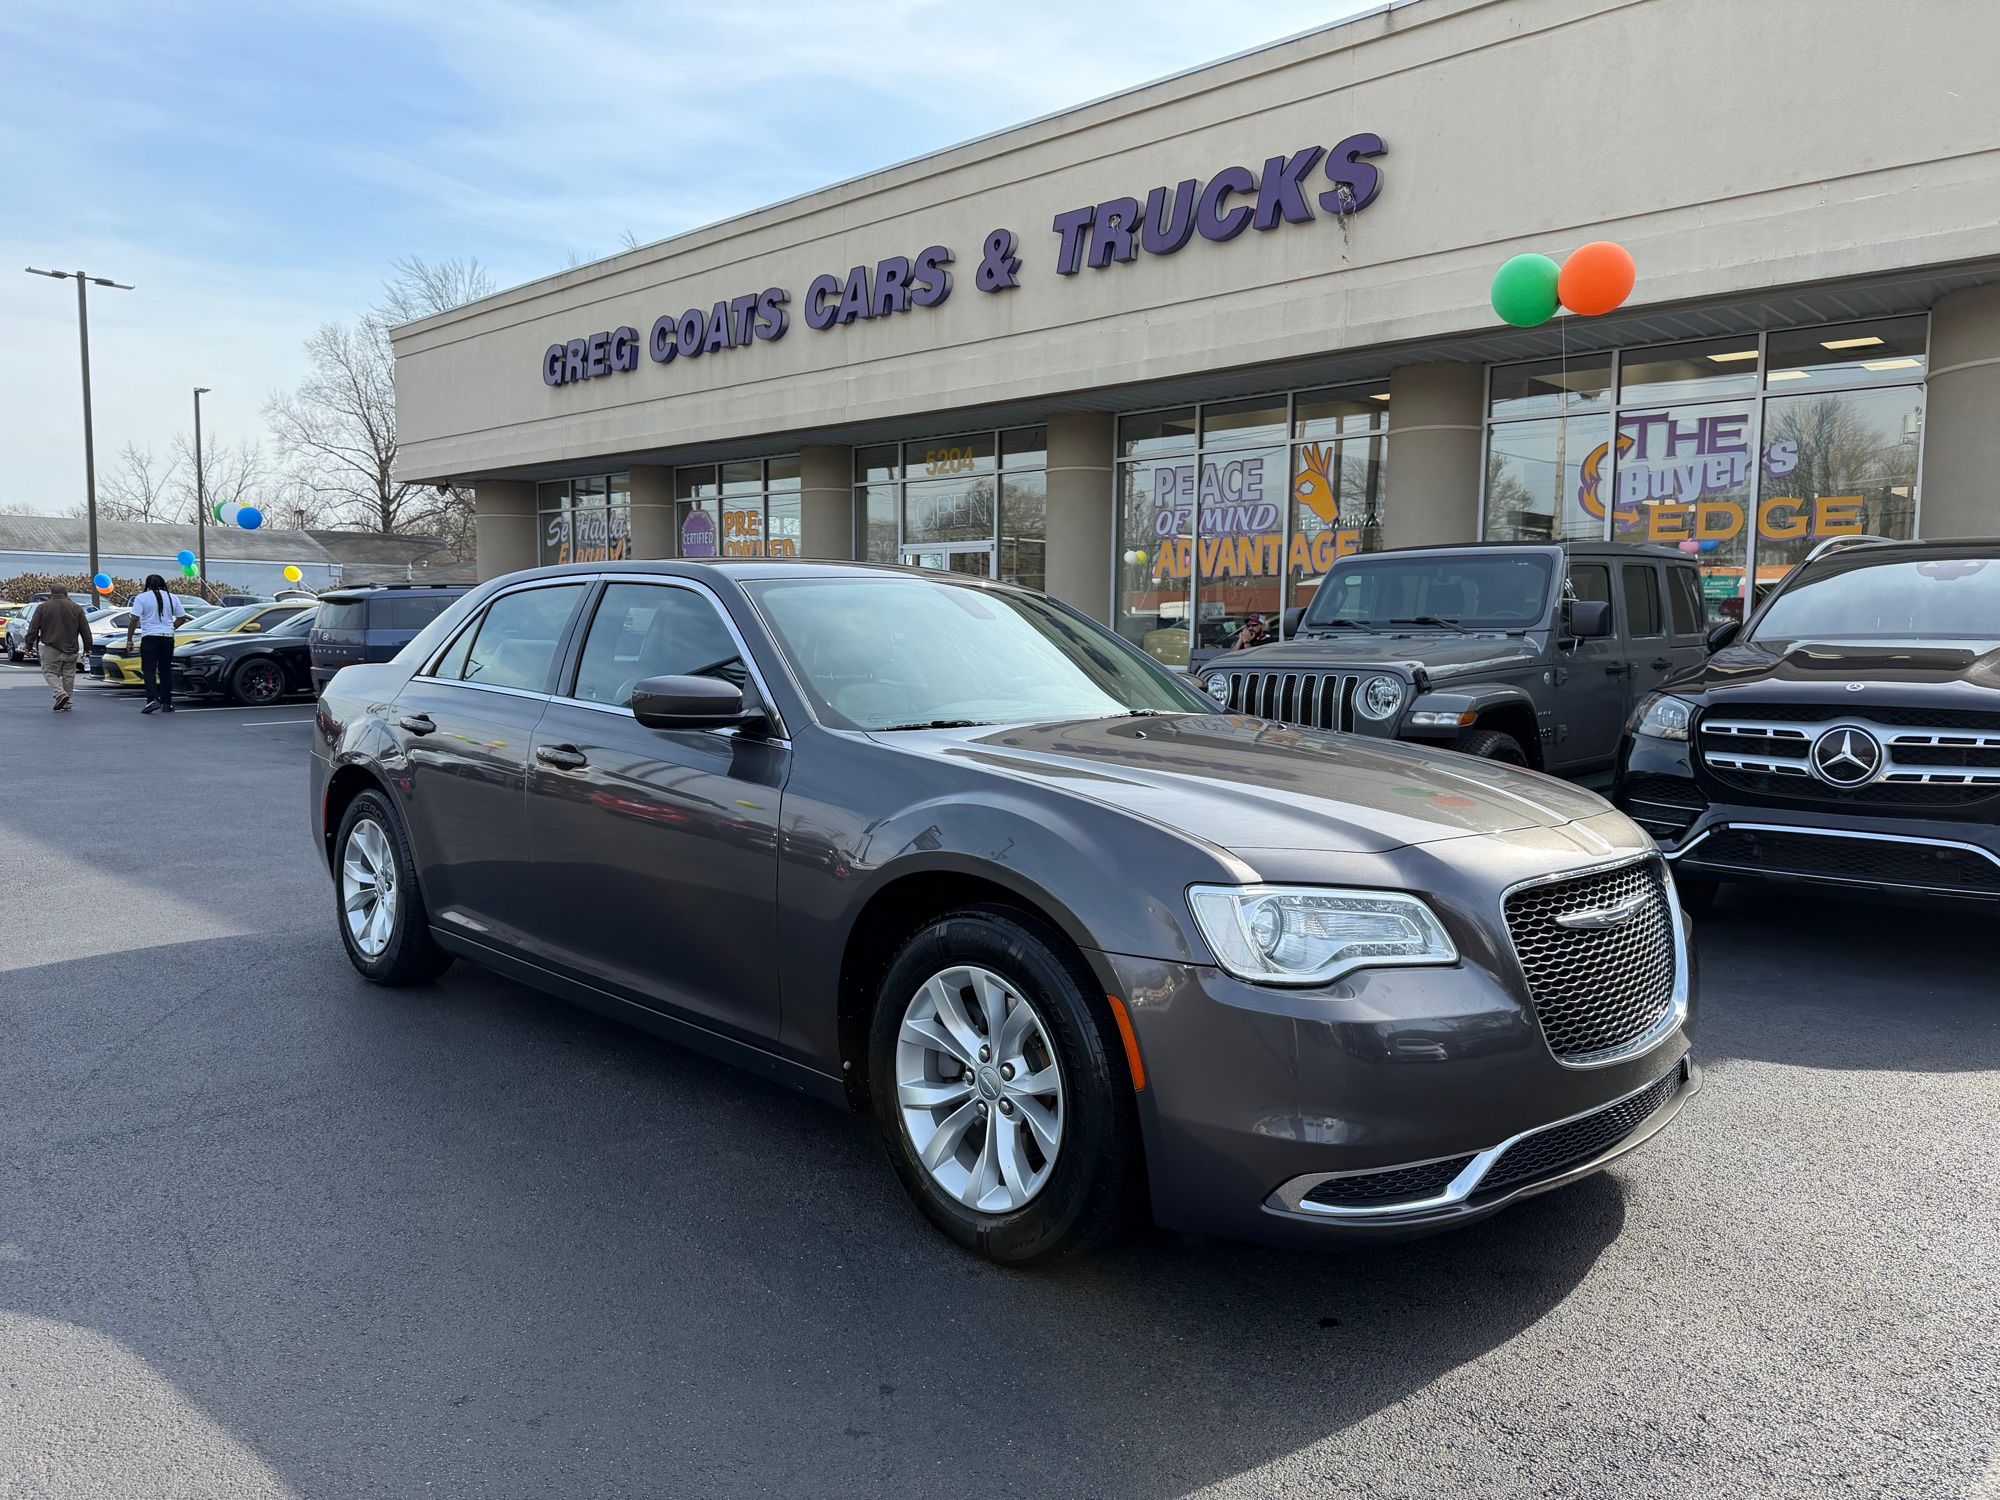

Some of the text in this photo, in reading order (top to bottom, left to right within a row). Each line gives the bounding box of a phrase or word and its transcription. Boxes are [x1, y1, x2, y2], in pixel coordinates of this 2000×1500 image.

[543, 133, 1387, 387] GREG COATS CARS & TRUCKS
[1617, 411, 1748, 461] THE
[925, 447, 974, 476] 5204
[1154, 458, 1263, 508] PEACE
[547, 509, 627, 547] Se Habla
[723, 510, 762, 538] PRE-
[916, 492, 988, 530] OPEN
[1155, 509, 1190, 536] OF
[1199, 503, 1278, 533] MIND
[1648, 495, 1864, 541] EDGE
[683, 531, 714, 545] CERTIFIED
[1153, 530, 1359, 578] ADVANTAGE
